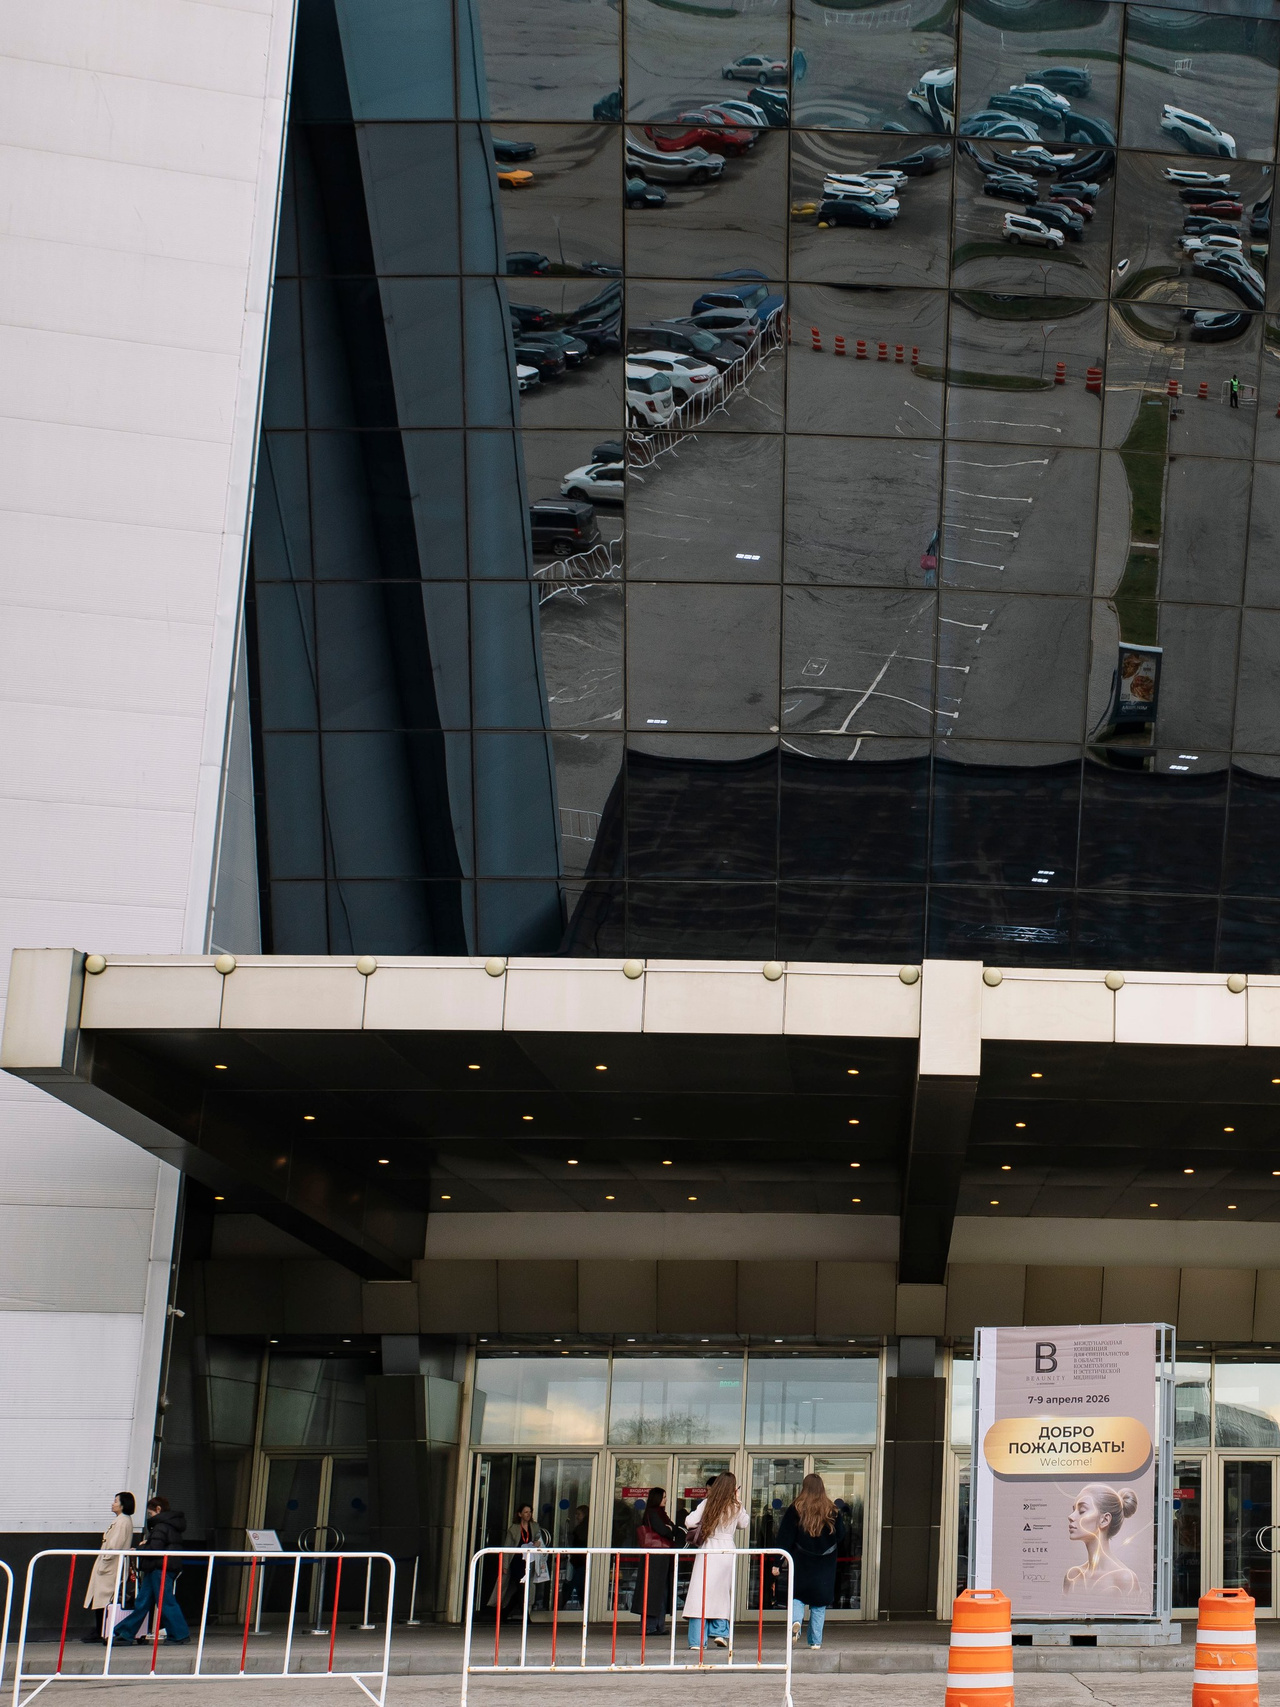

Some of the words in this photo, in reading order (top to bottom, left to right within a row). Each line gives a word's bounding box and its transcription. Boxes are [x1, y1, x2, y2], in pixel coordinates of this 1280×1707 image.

[1035, 1342, 1057, 1373] B
[1028, 1395, 1043, 1404] 7-9
[1046, 1396, 1083, 1405] апреля
[1085, 1394, 1110, 1403] 2026
[1038, 1425, 1094, 1440] ДОБРО
[1008, 1441, 1125, 1454] ПОЖАЛОВАТЬ!
[1040, 1457, 1093, 1467] Welcome!
